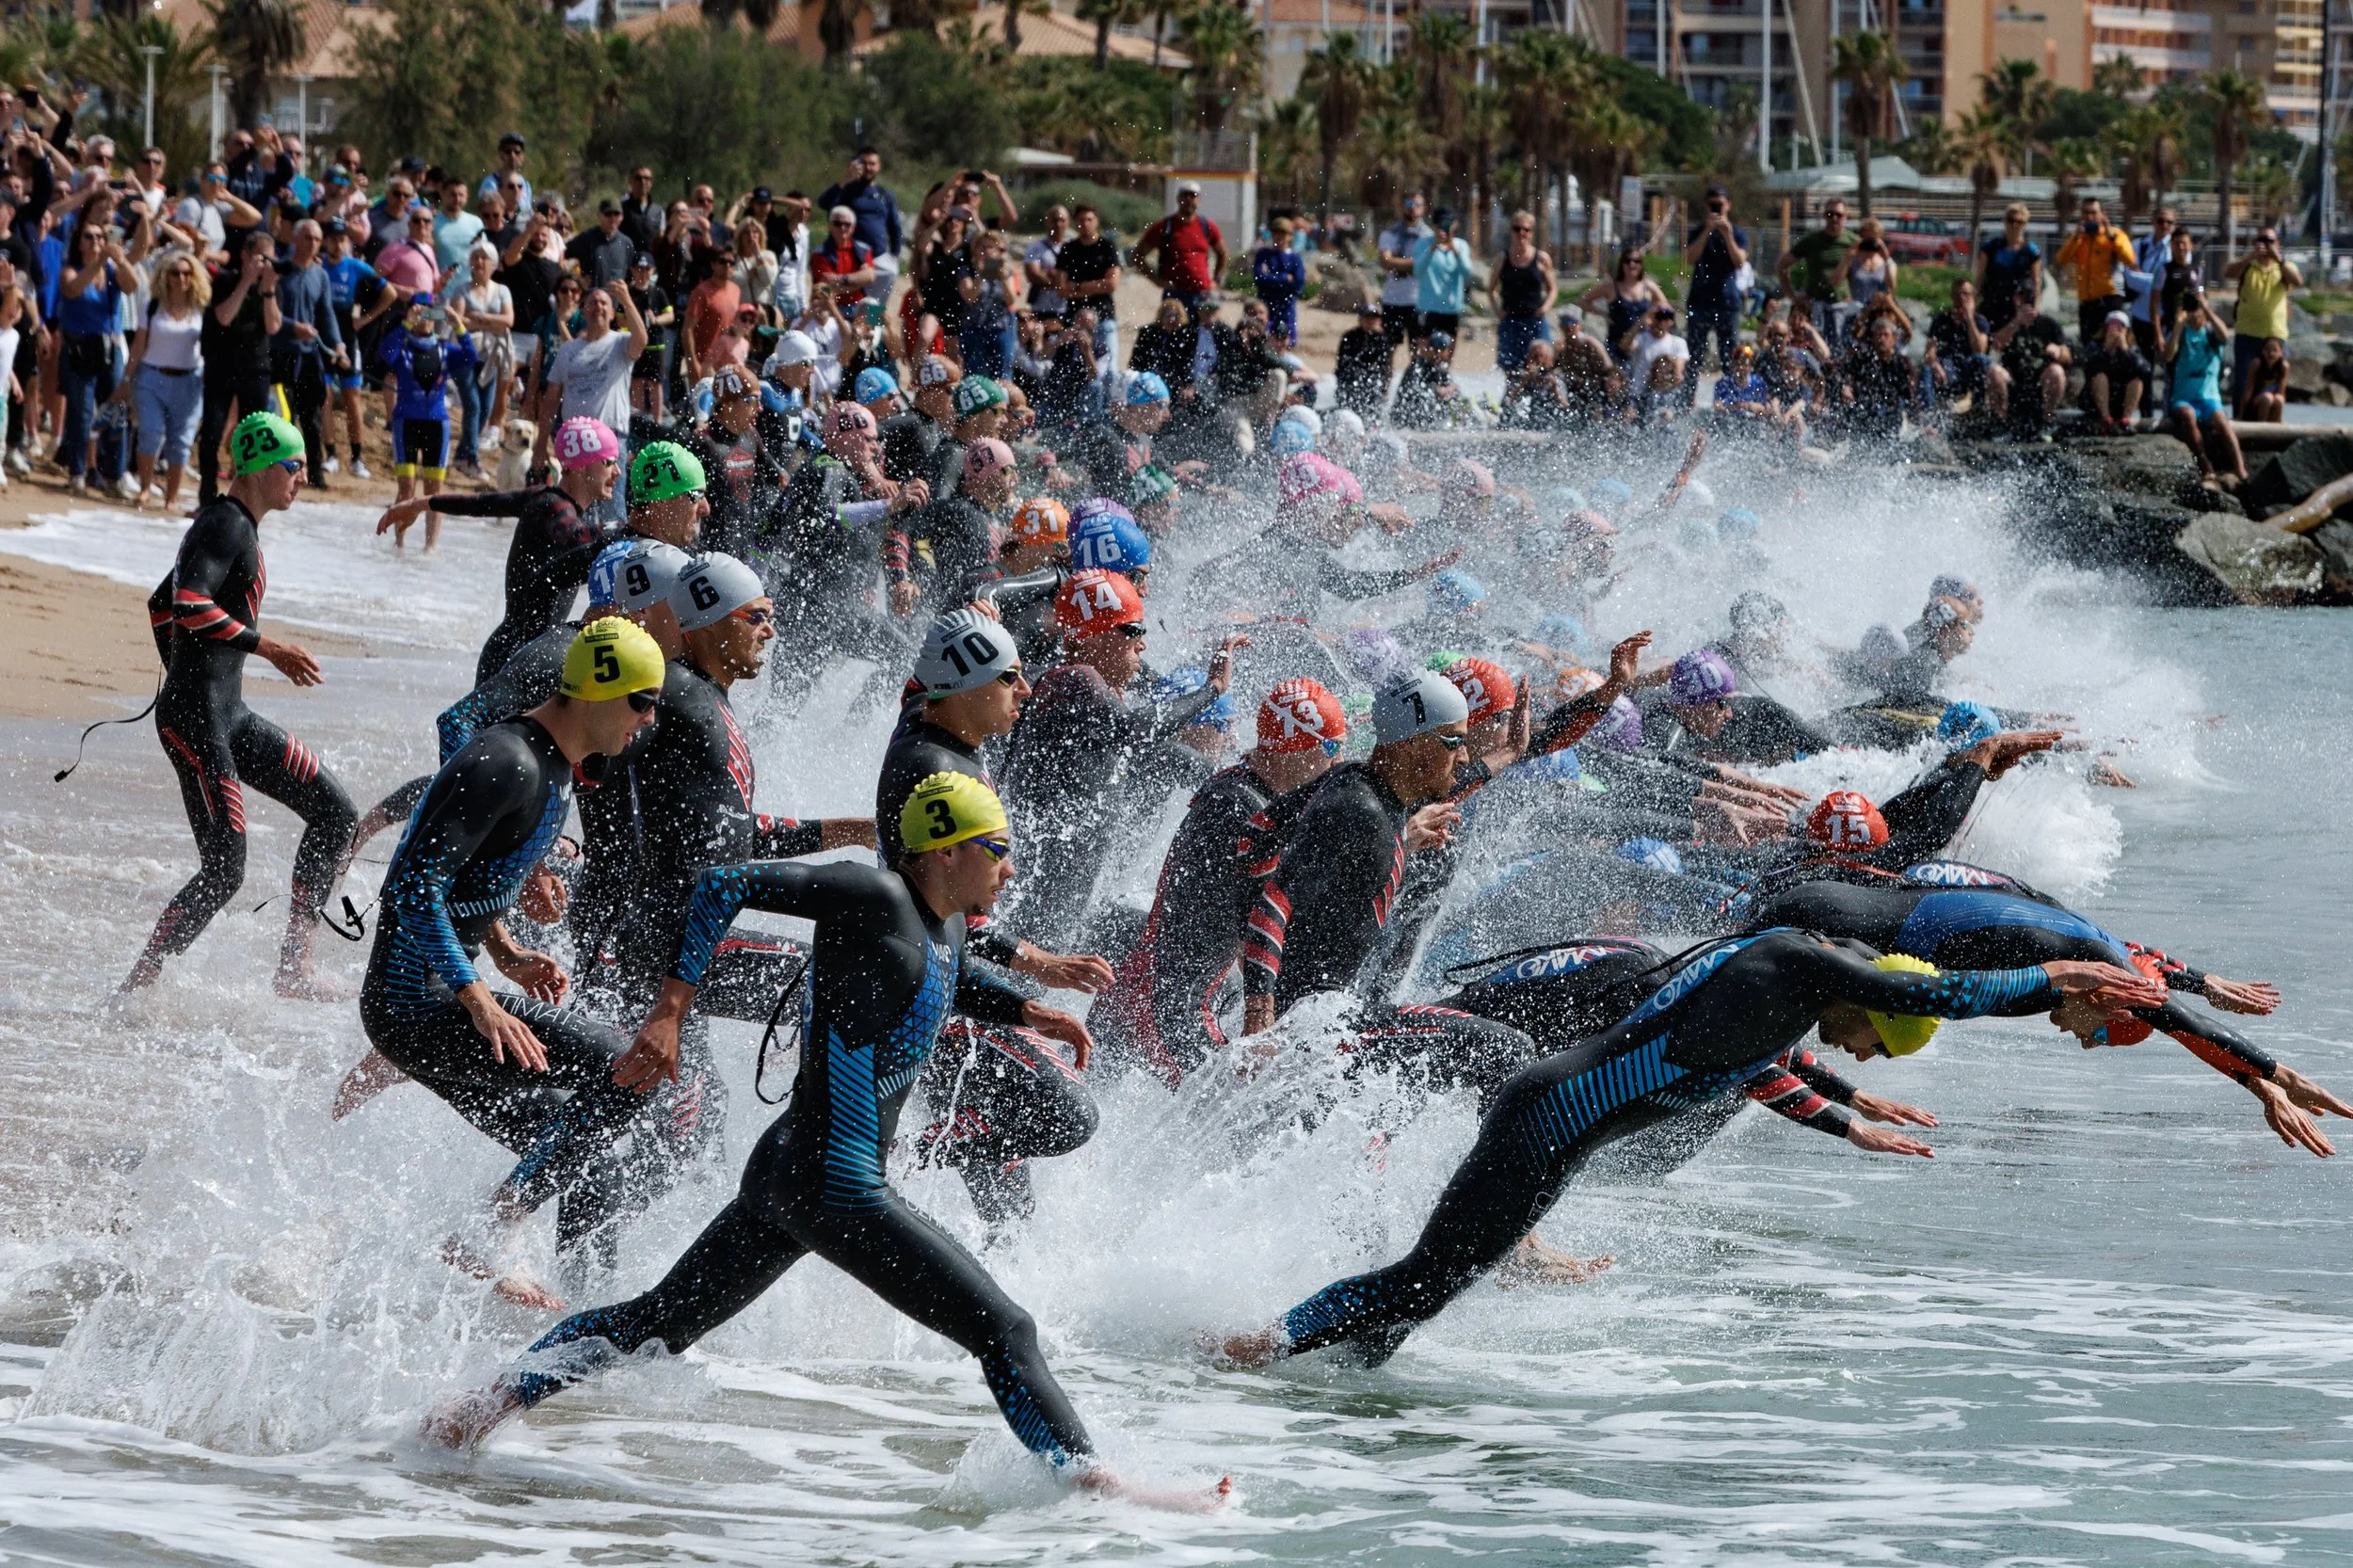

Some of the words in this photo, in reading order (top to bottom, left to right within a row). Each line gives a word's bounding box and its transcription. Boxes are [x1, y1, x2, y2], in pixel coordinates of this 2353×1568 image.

[715, 374, 744, 397] 70
[959, 384, 990, 411] 65
[239, 426, 280, 462] 23
[563, 428, 602, 458] 38
[643, 458, 681, 489] 21
[1023, 509, 1059, 535] 31
[1077, 533, 1123, 568] 16
[594, 560, 616, 595] 1
[626, 563, 651, 598] 9
[689, 575, 720, 612] 6
[1070, 581, 1123, 621] 14
[594, 645, 621, 684] 5
[941, 632, 1000, 678] 10
[1401, 690, 1427, 727] 7
[1462, 677, 1490, 712] 2
[1277, 699, 1324, 739] 13
[925, 798, 957, 840] 3
[1825, 814, 1871, 844] 15
[1915, 863, 1988, 887] MAKO
[1516, 946, 1607, 979] MAKO
[1653, 943, 1738, 1010] MAKO
[501, 993, 587, 1032] TIMATE
